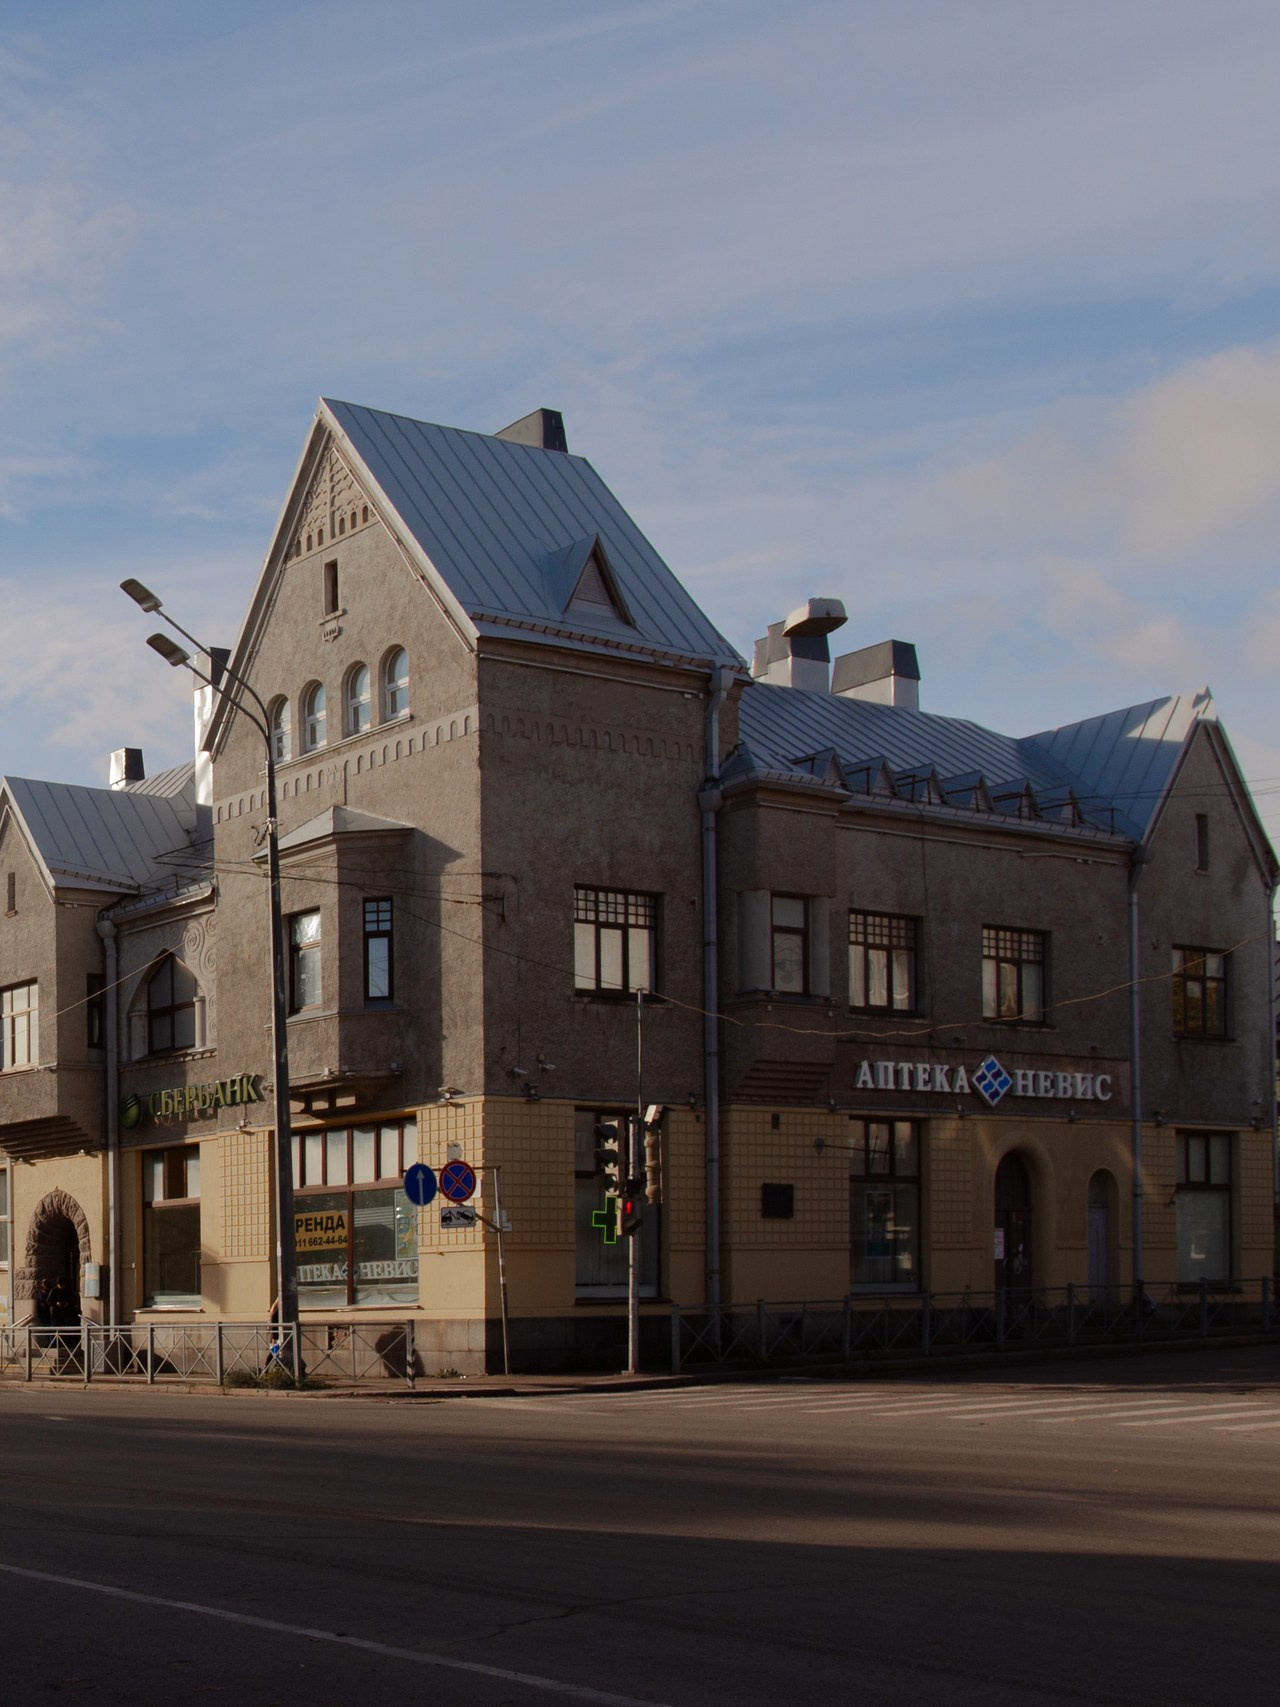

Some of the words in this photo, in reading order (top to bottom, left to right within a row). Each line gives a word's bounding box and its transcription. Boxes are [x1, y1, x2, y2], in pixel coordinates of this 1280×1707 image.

[856, 1060, 970, 1093] АПТЕКА
[1012, 1069, 1112, 1101] НЕВИС
[149, 1074, 258, 1117] СБЕРБАНК
[295, 1215, 346, 1233] РЕНДА
[308, 1235, 348, 1247] 662-44-64
[297, 1263, 342, 1282] ПТЕКА
[360, 1260, 418, 1279] НЕВИС
